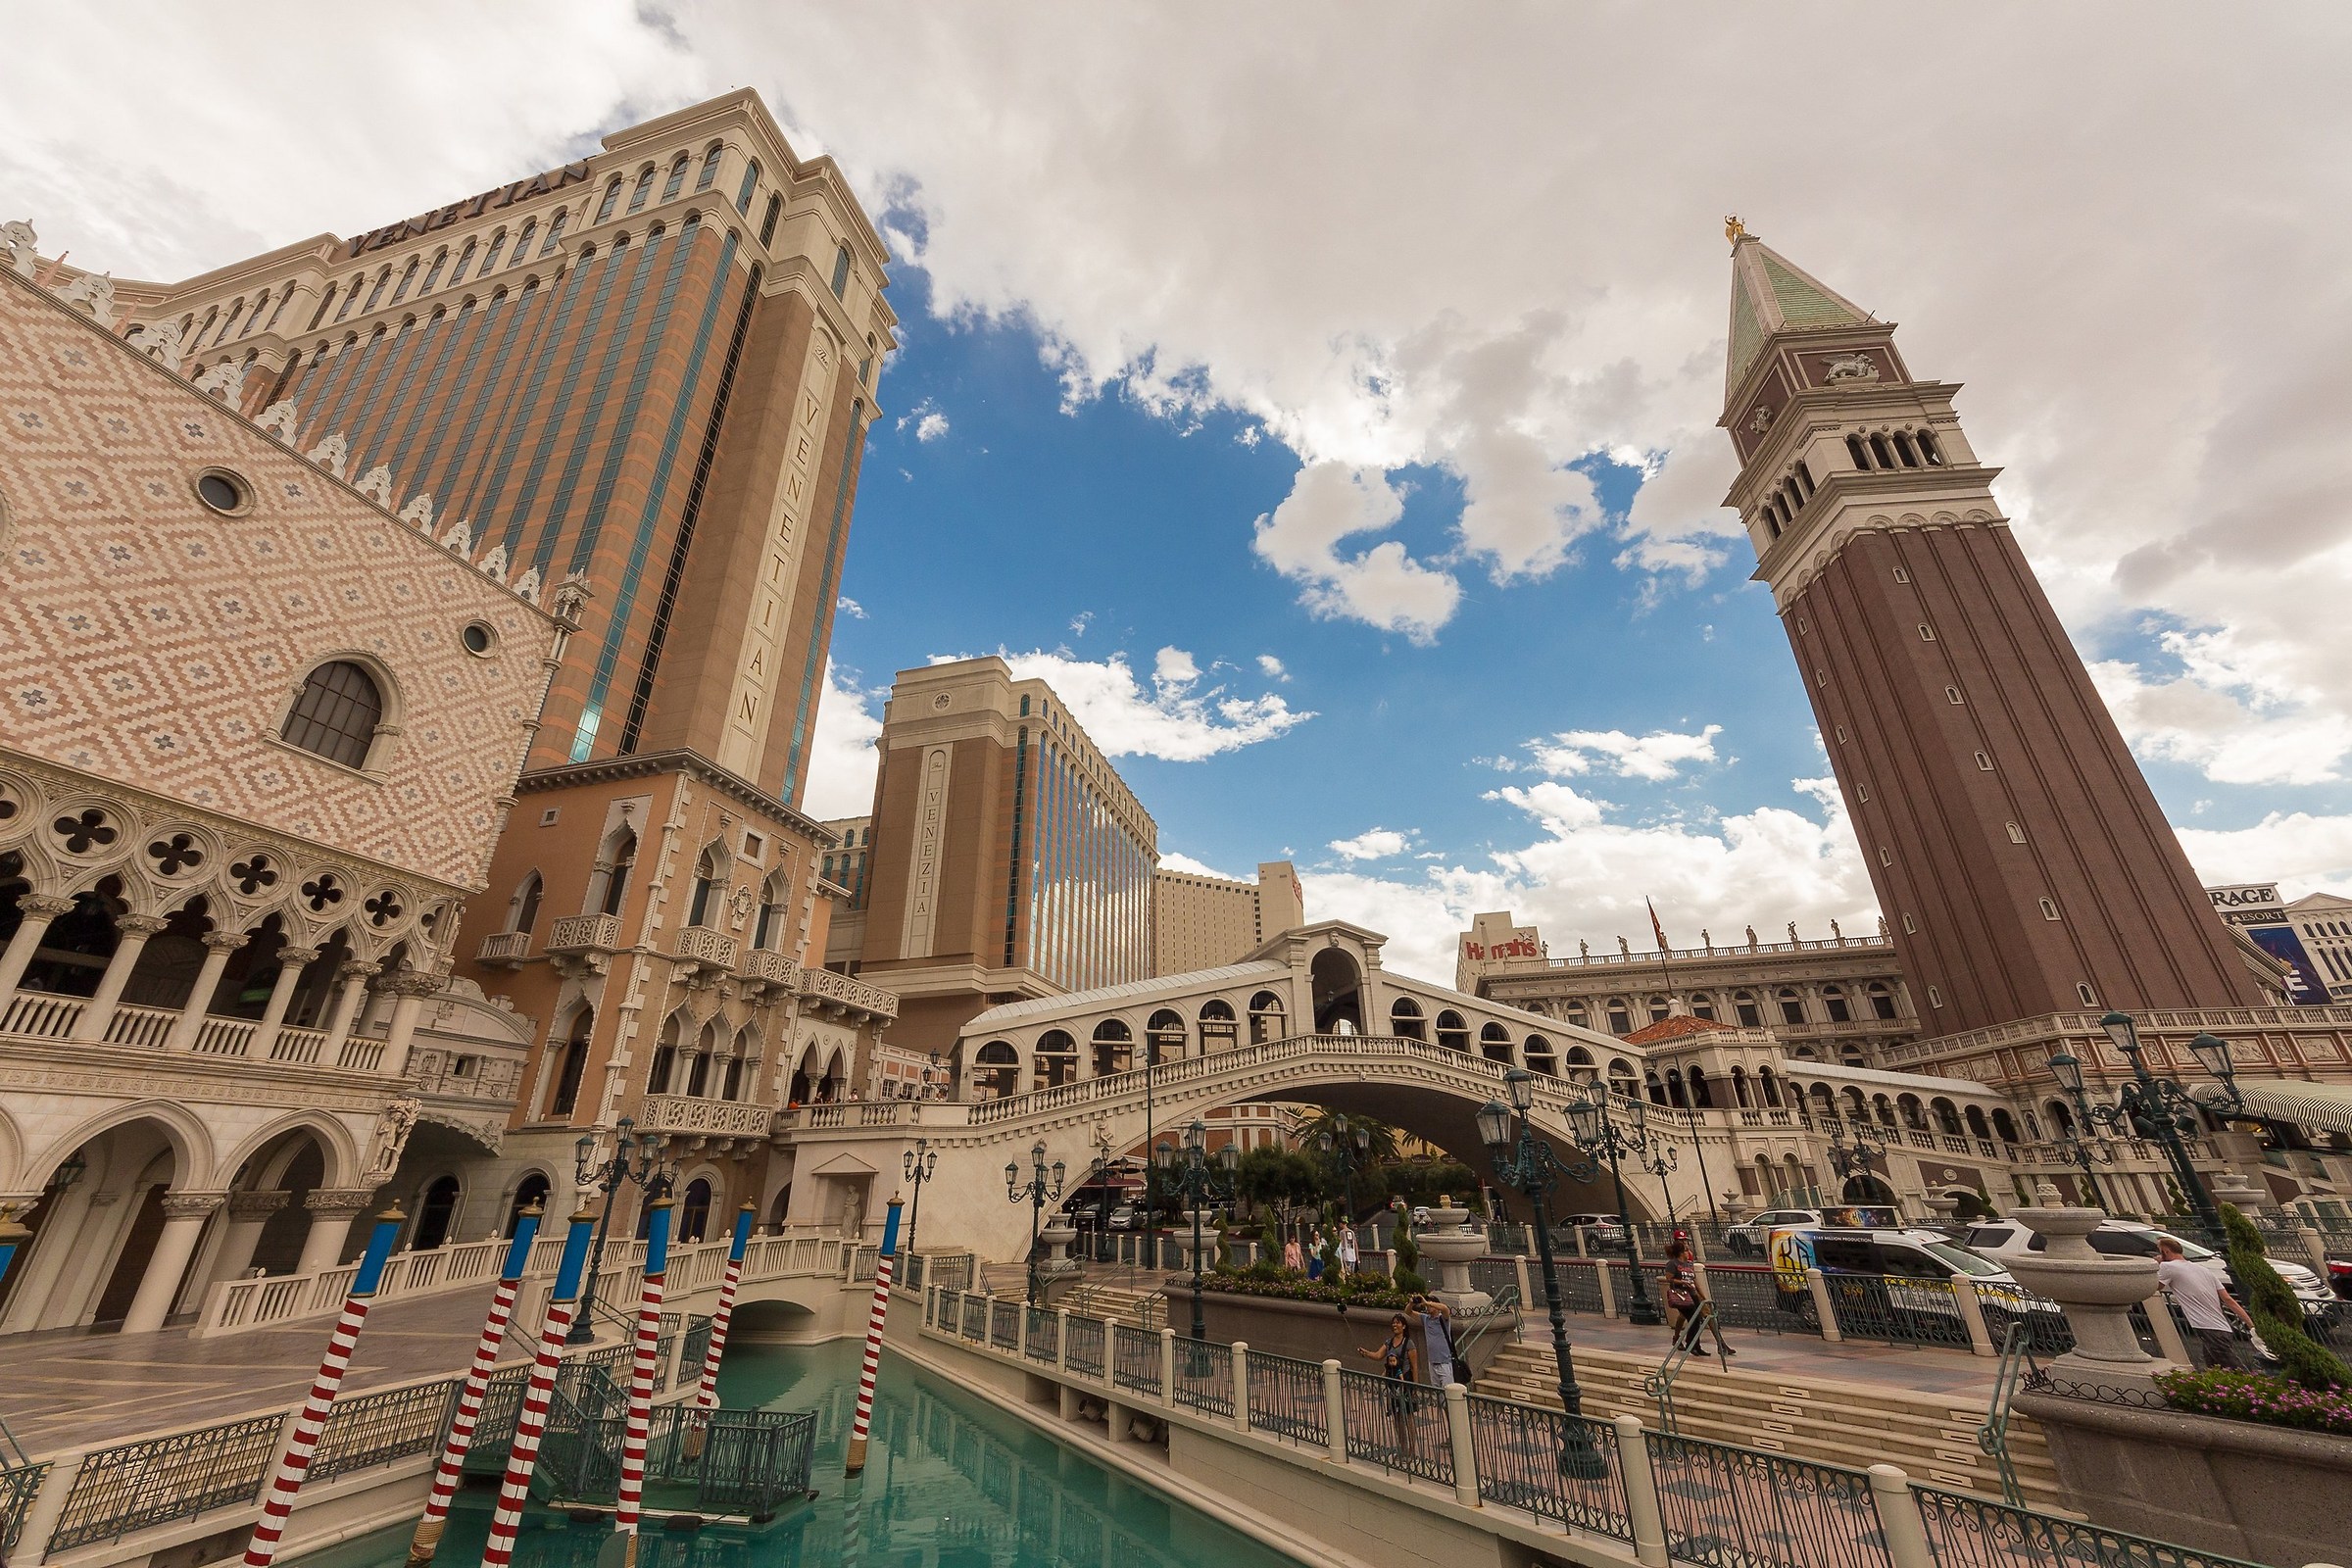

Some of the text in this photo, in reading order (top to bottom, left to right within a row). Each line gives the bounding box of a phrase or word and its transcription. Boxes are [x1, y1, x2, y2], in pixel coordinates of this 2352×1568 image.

[348, 155, 597, 258] VENETIAN
[738, 395, 819, 726] VENETIAN
[916, 791, 939, 913] VENEZIA
[2209, 888, 2275, 906] RAGE
